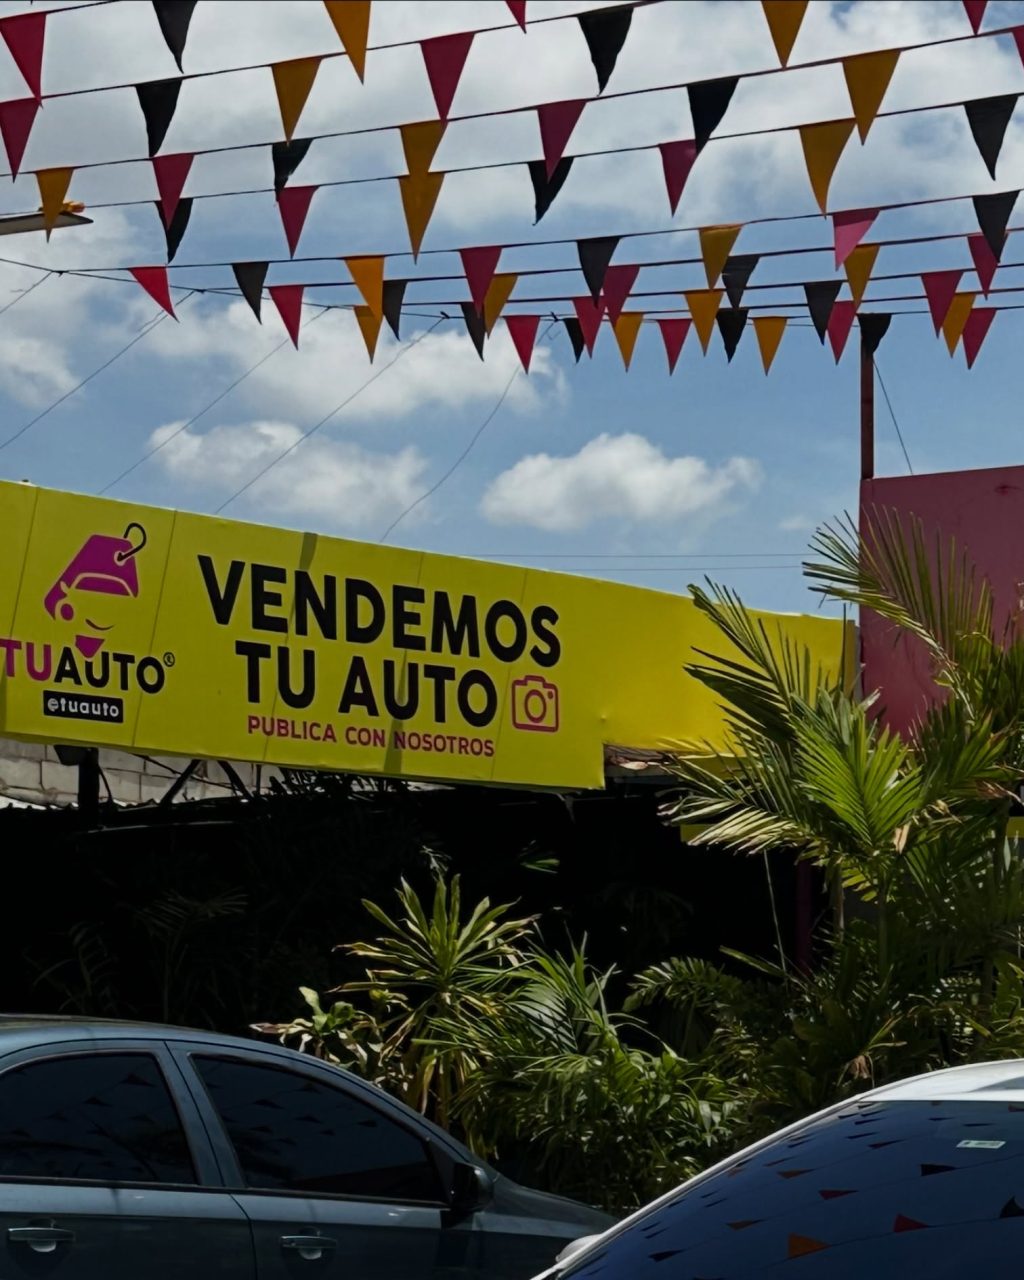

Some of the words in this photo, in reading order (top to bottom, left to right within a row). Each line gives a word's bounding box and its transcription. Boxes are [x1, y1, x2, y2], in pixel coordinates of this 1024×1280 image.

[197, 555, 561, 667] VENDEMOS
[235, 640, 316, 709] TU
[338, 655, 498, 728] AUTO
[248, 715, 337, 743] PUBLICA
[345, 726, 386, 748] CON
[394, 731, 495, 757] NOSOTROS
